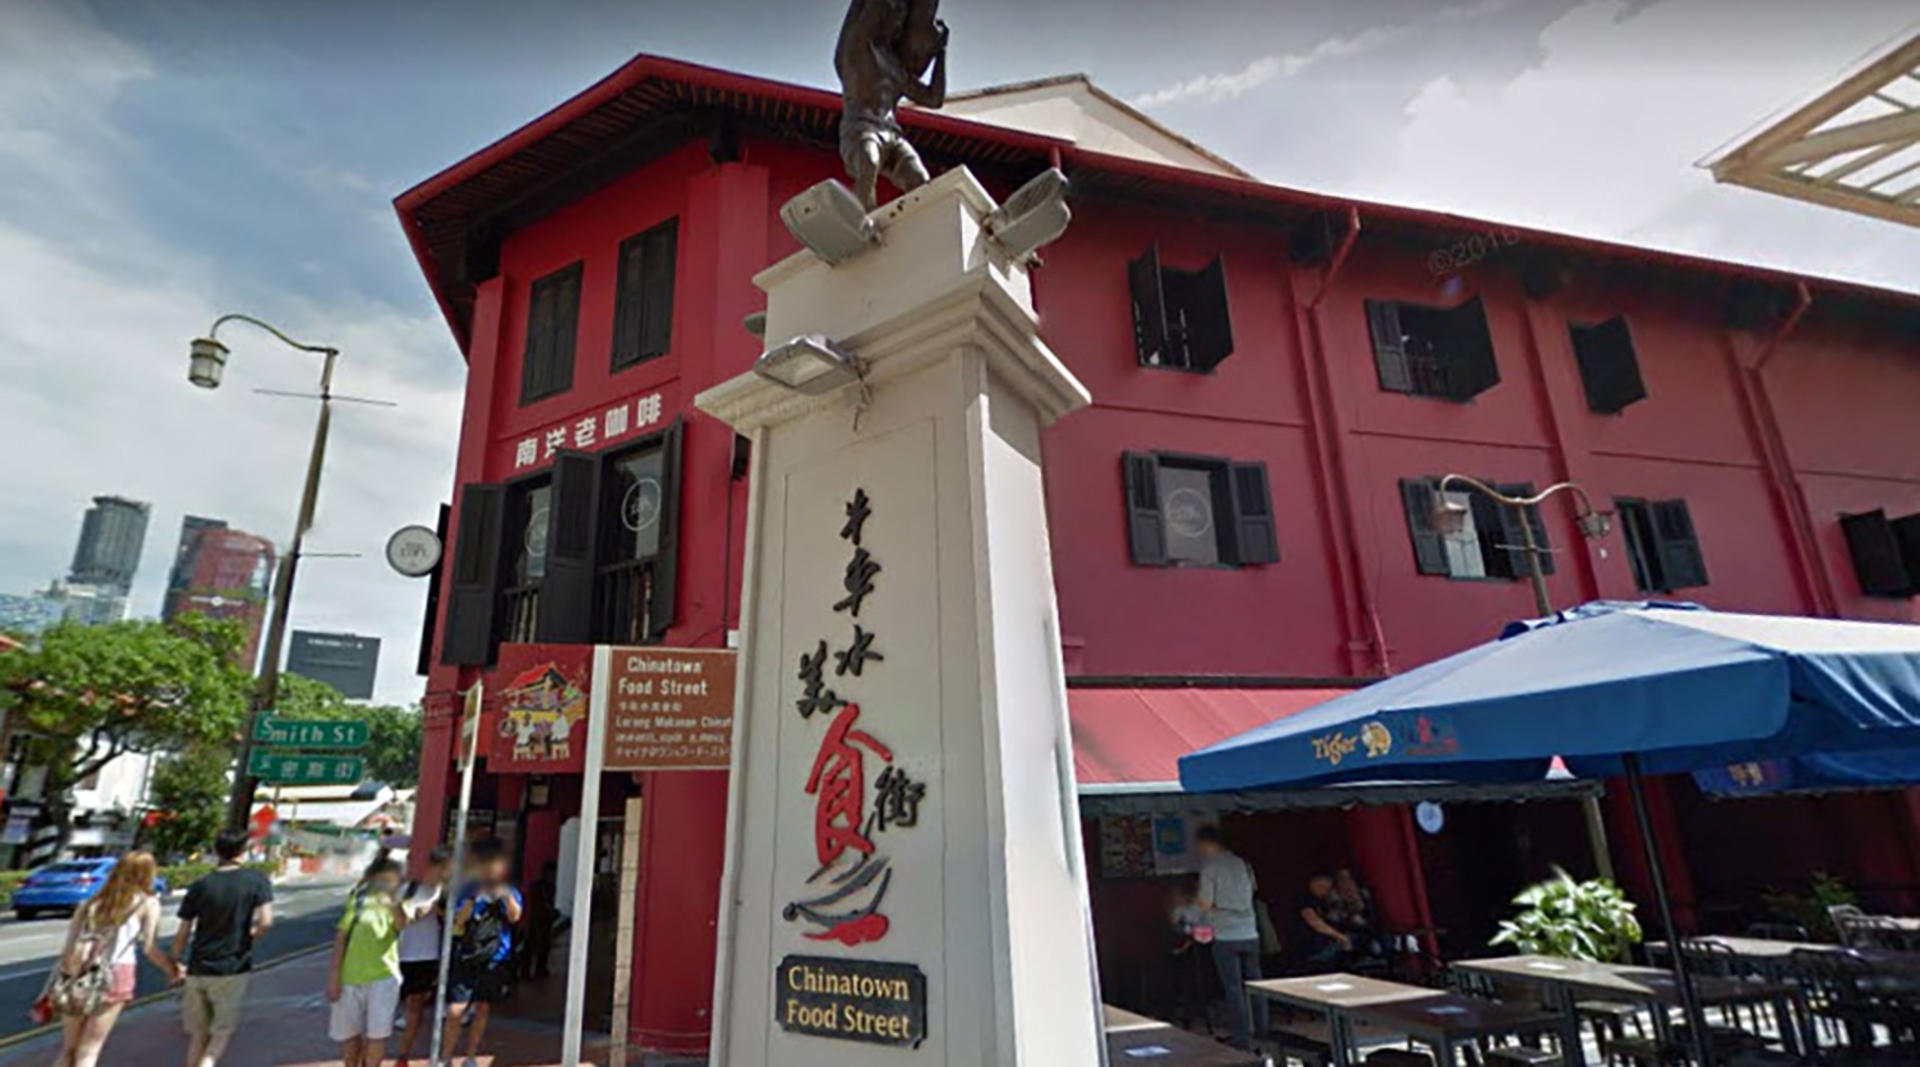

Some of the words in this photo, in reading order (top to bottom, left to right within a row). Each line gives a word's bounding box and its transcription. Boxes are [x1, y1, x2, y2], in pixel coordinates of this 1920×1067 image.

[515, 393, 662, 469] 南洋老咖啡
[627, 656, 703, 673] Chinatown
[618, 677, 652, 694] Food
[660, 678, 707, 695] Street
[263, 717, 324, 742] Smith
[333, 725, 355, 742] St
[1312, 731, 1358, 765] Tiger
[788, 964, 910, 1001] Chinatown
[787, 998, 838, 1030] Food
[843, 1005, 911, 1039] Street
